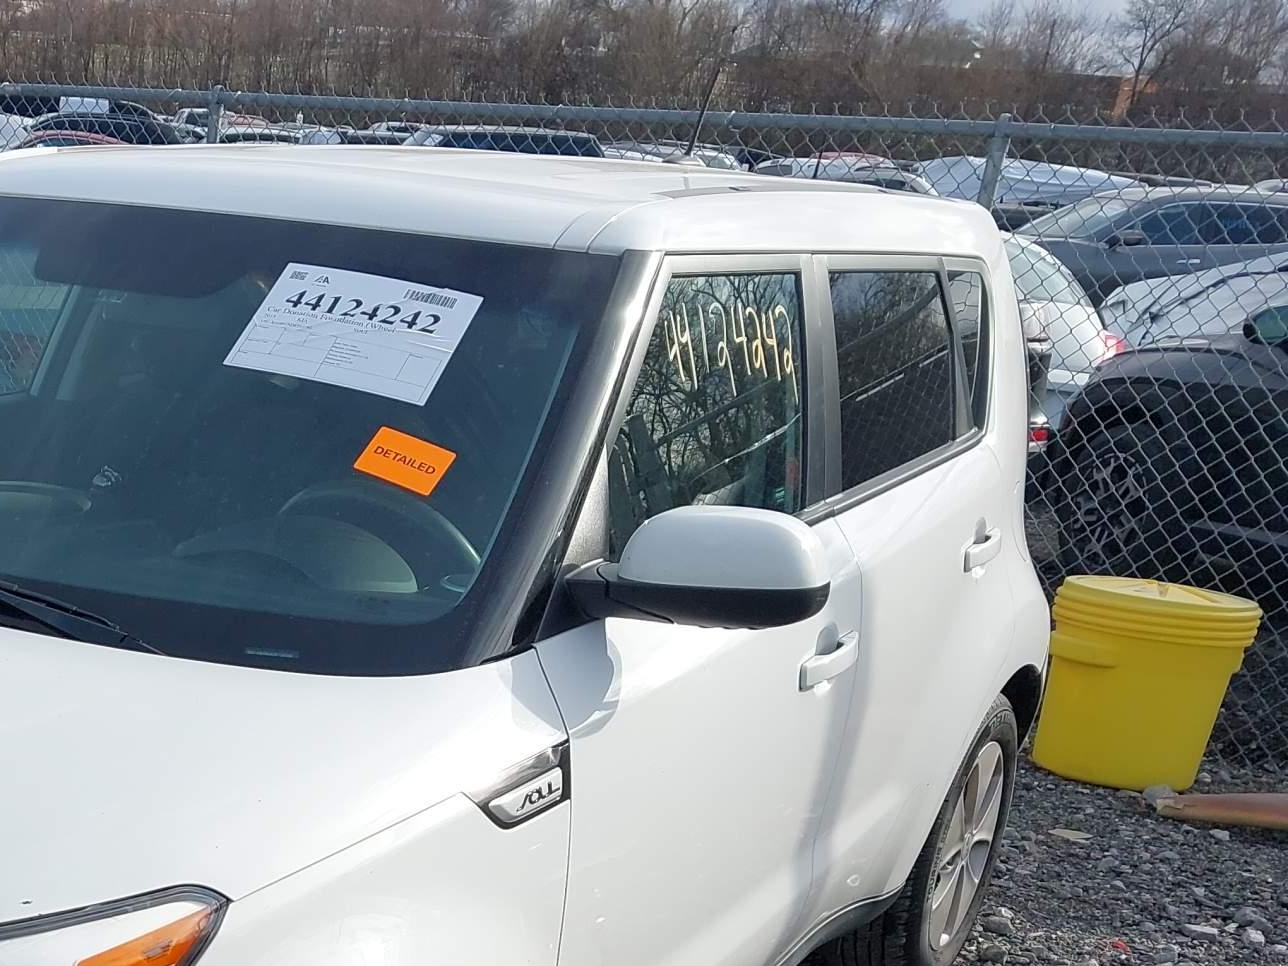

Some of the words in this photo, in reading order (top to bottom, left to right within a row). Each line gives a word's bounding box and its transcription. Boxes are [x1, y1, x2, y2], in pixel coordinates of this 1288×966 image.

[285, 289, 442, 335] 44124242
[665, 302, 799, 405] 44124242
[374, 445, 436, 476] DETAILED
